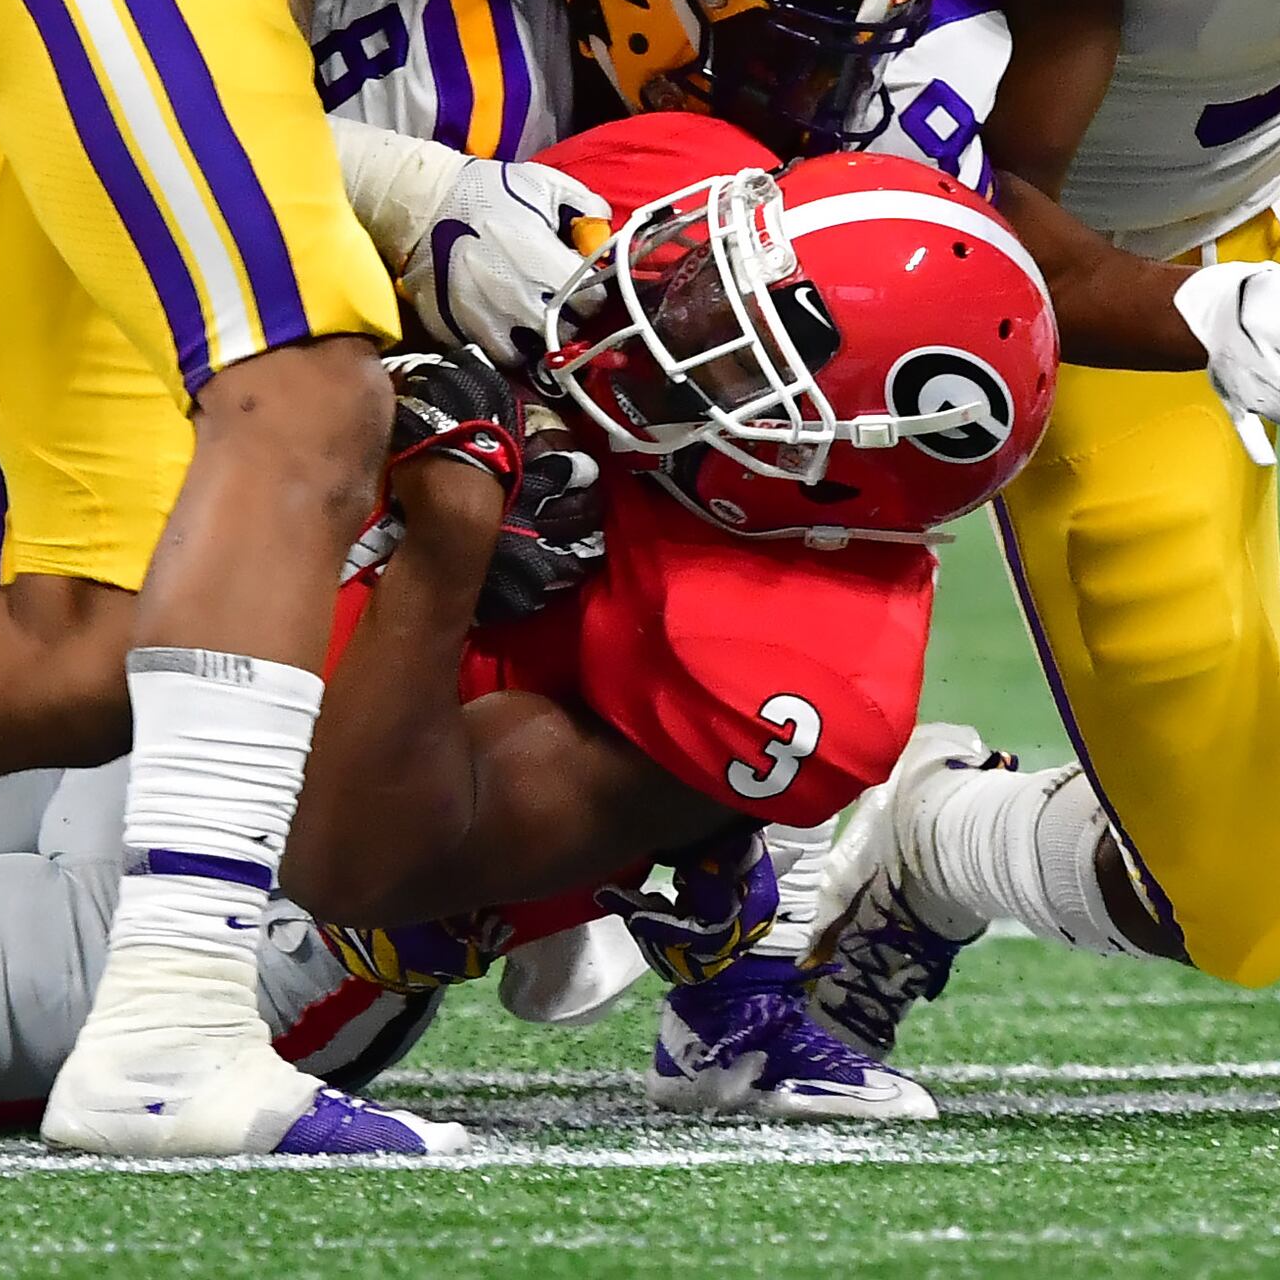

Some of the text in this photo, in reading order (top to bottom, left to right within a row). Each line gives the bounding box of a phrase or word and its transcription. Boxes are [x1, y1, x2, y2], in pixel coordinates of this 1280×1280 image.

[311, 2, 410, 114] 8
[884, 344, 1015, 464] G
[726, 692, 822, 799] 3
